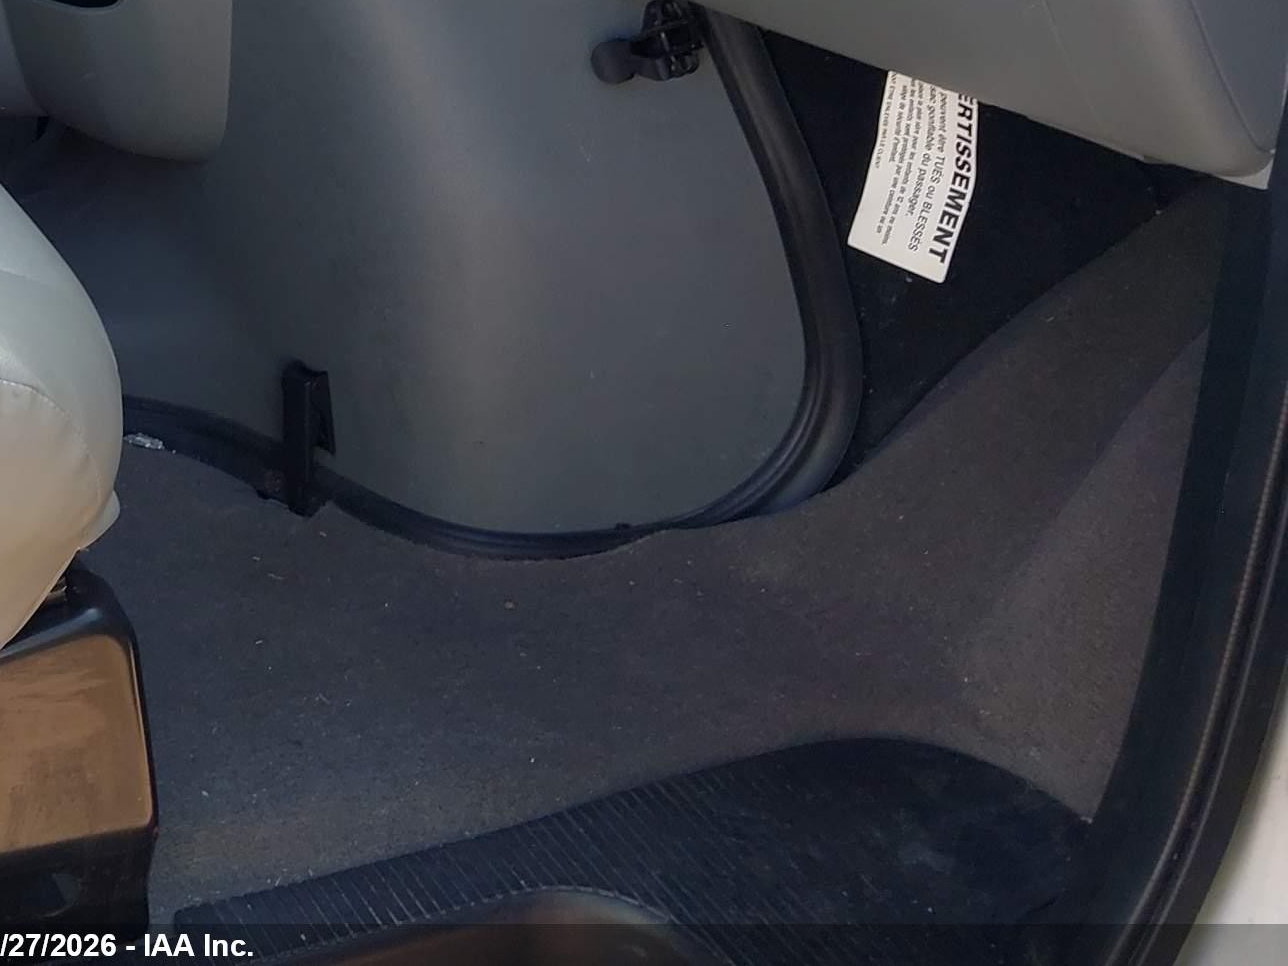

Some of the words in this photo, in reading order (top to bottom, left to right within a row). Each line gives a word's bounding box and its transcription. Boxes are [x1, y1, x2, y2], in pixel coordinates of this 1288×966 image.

[925, 105, 935, 151] gonflable
[938, 93, 948, 132] peuvent
[921, 153, 932, 166] du
[905, 168, 927, 216] passager.
[925, 185, 935, 199] ou
